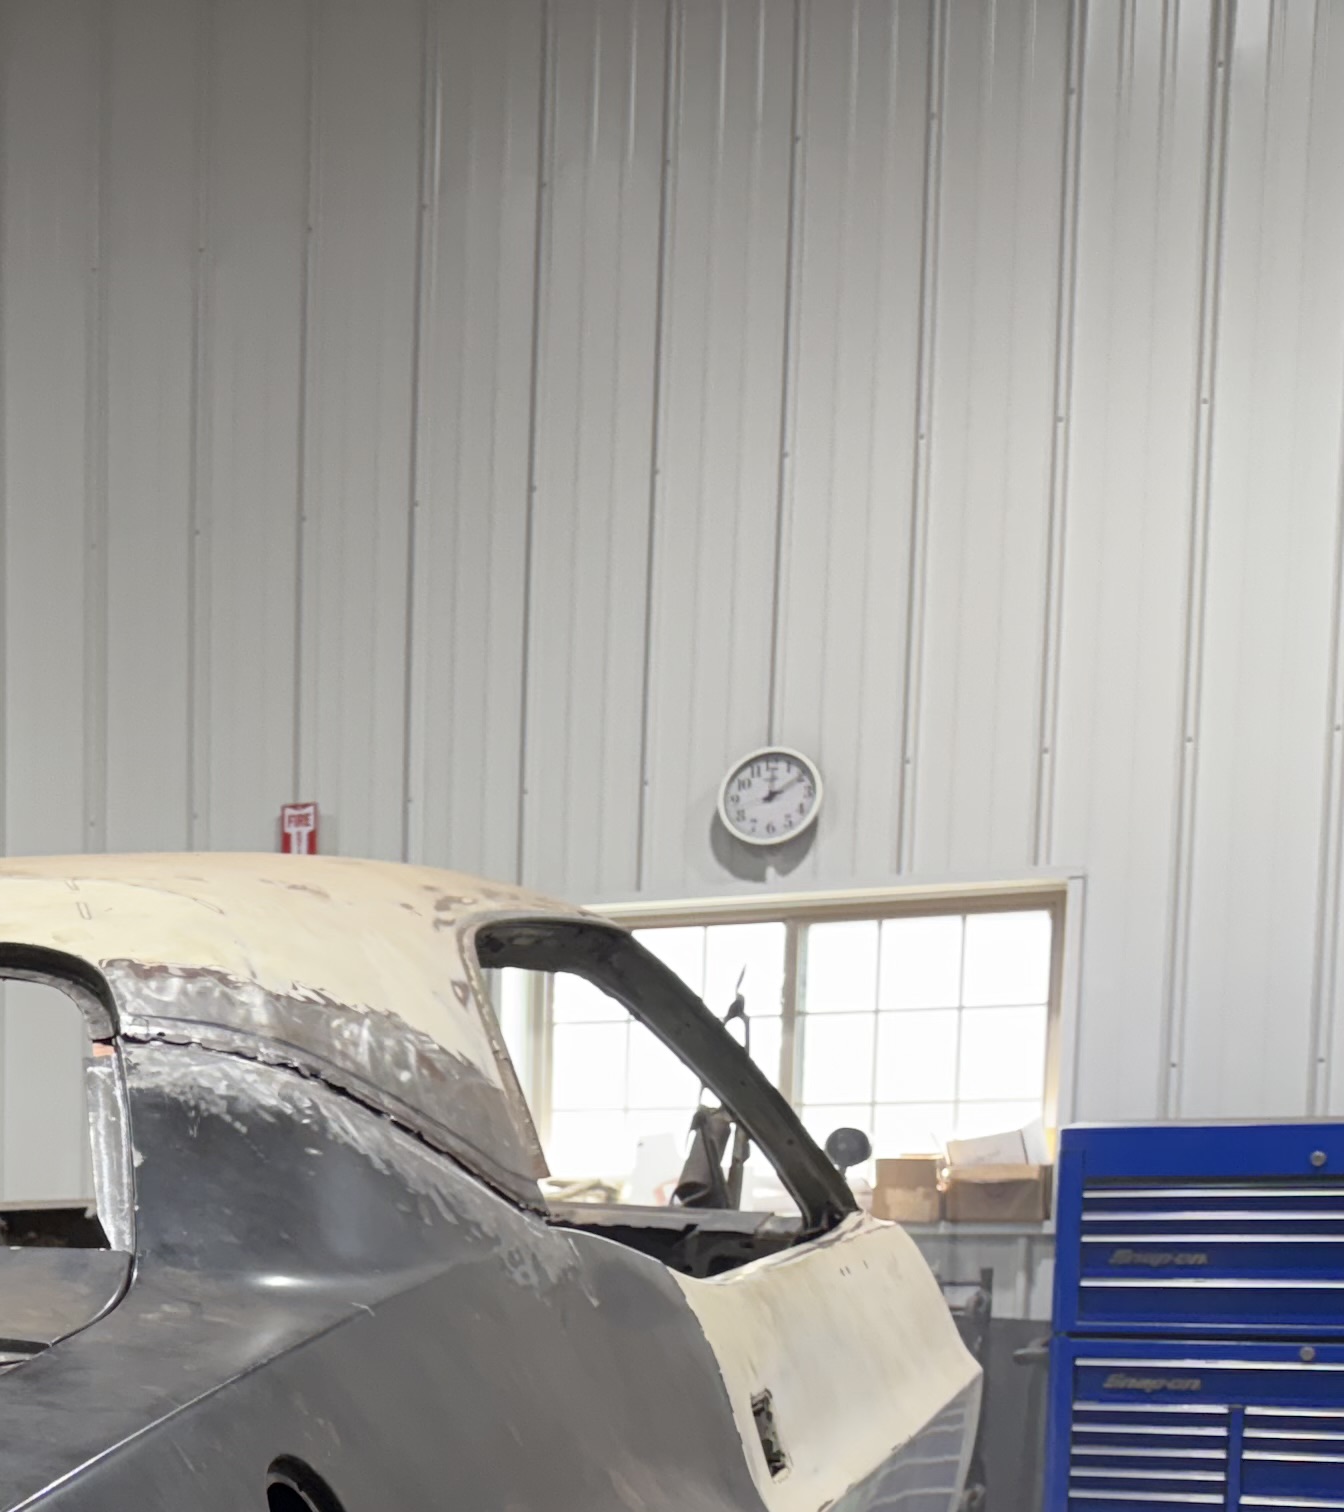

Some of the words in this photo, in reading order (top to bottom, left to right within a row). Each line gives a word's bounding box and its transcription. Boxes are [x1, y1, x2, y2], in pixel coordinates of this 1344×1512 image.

[750, 764, 761, 779] 11
[737, 778, 752, 791] 10
[287, 813, 312, 828] FIRE
[765, 822, 776, 835] 6
[1109, 1249, 1208, 1267] Snap-on
[1103, 1374, 1201, 1393] Snap-on
